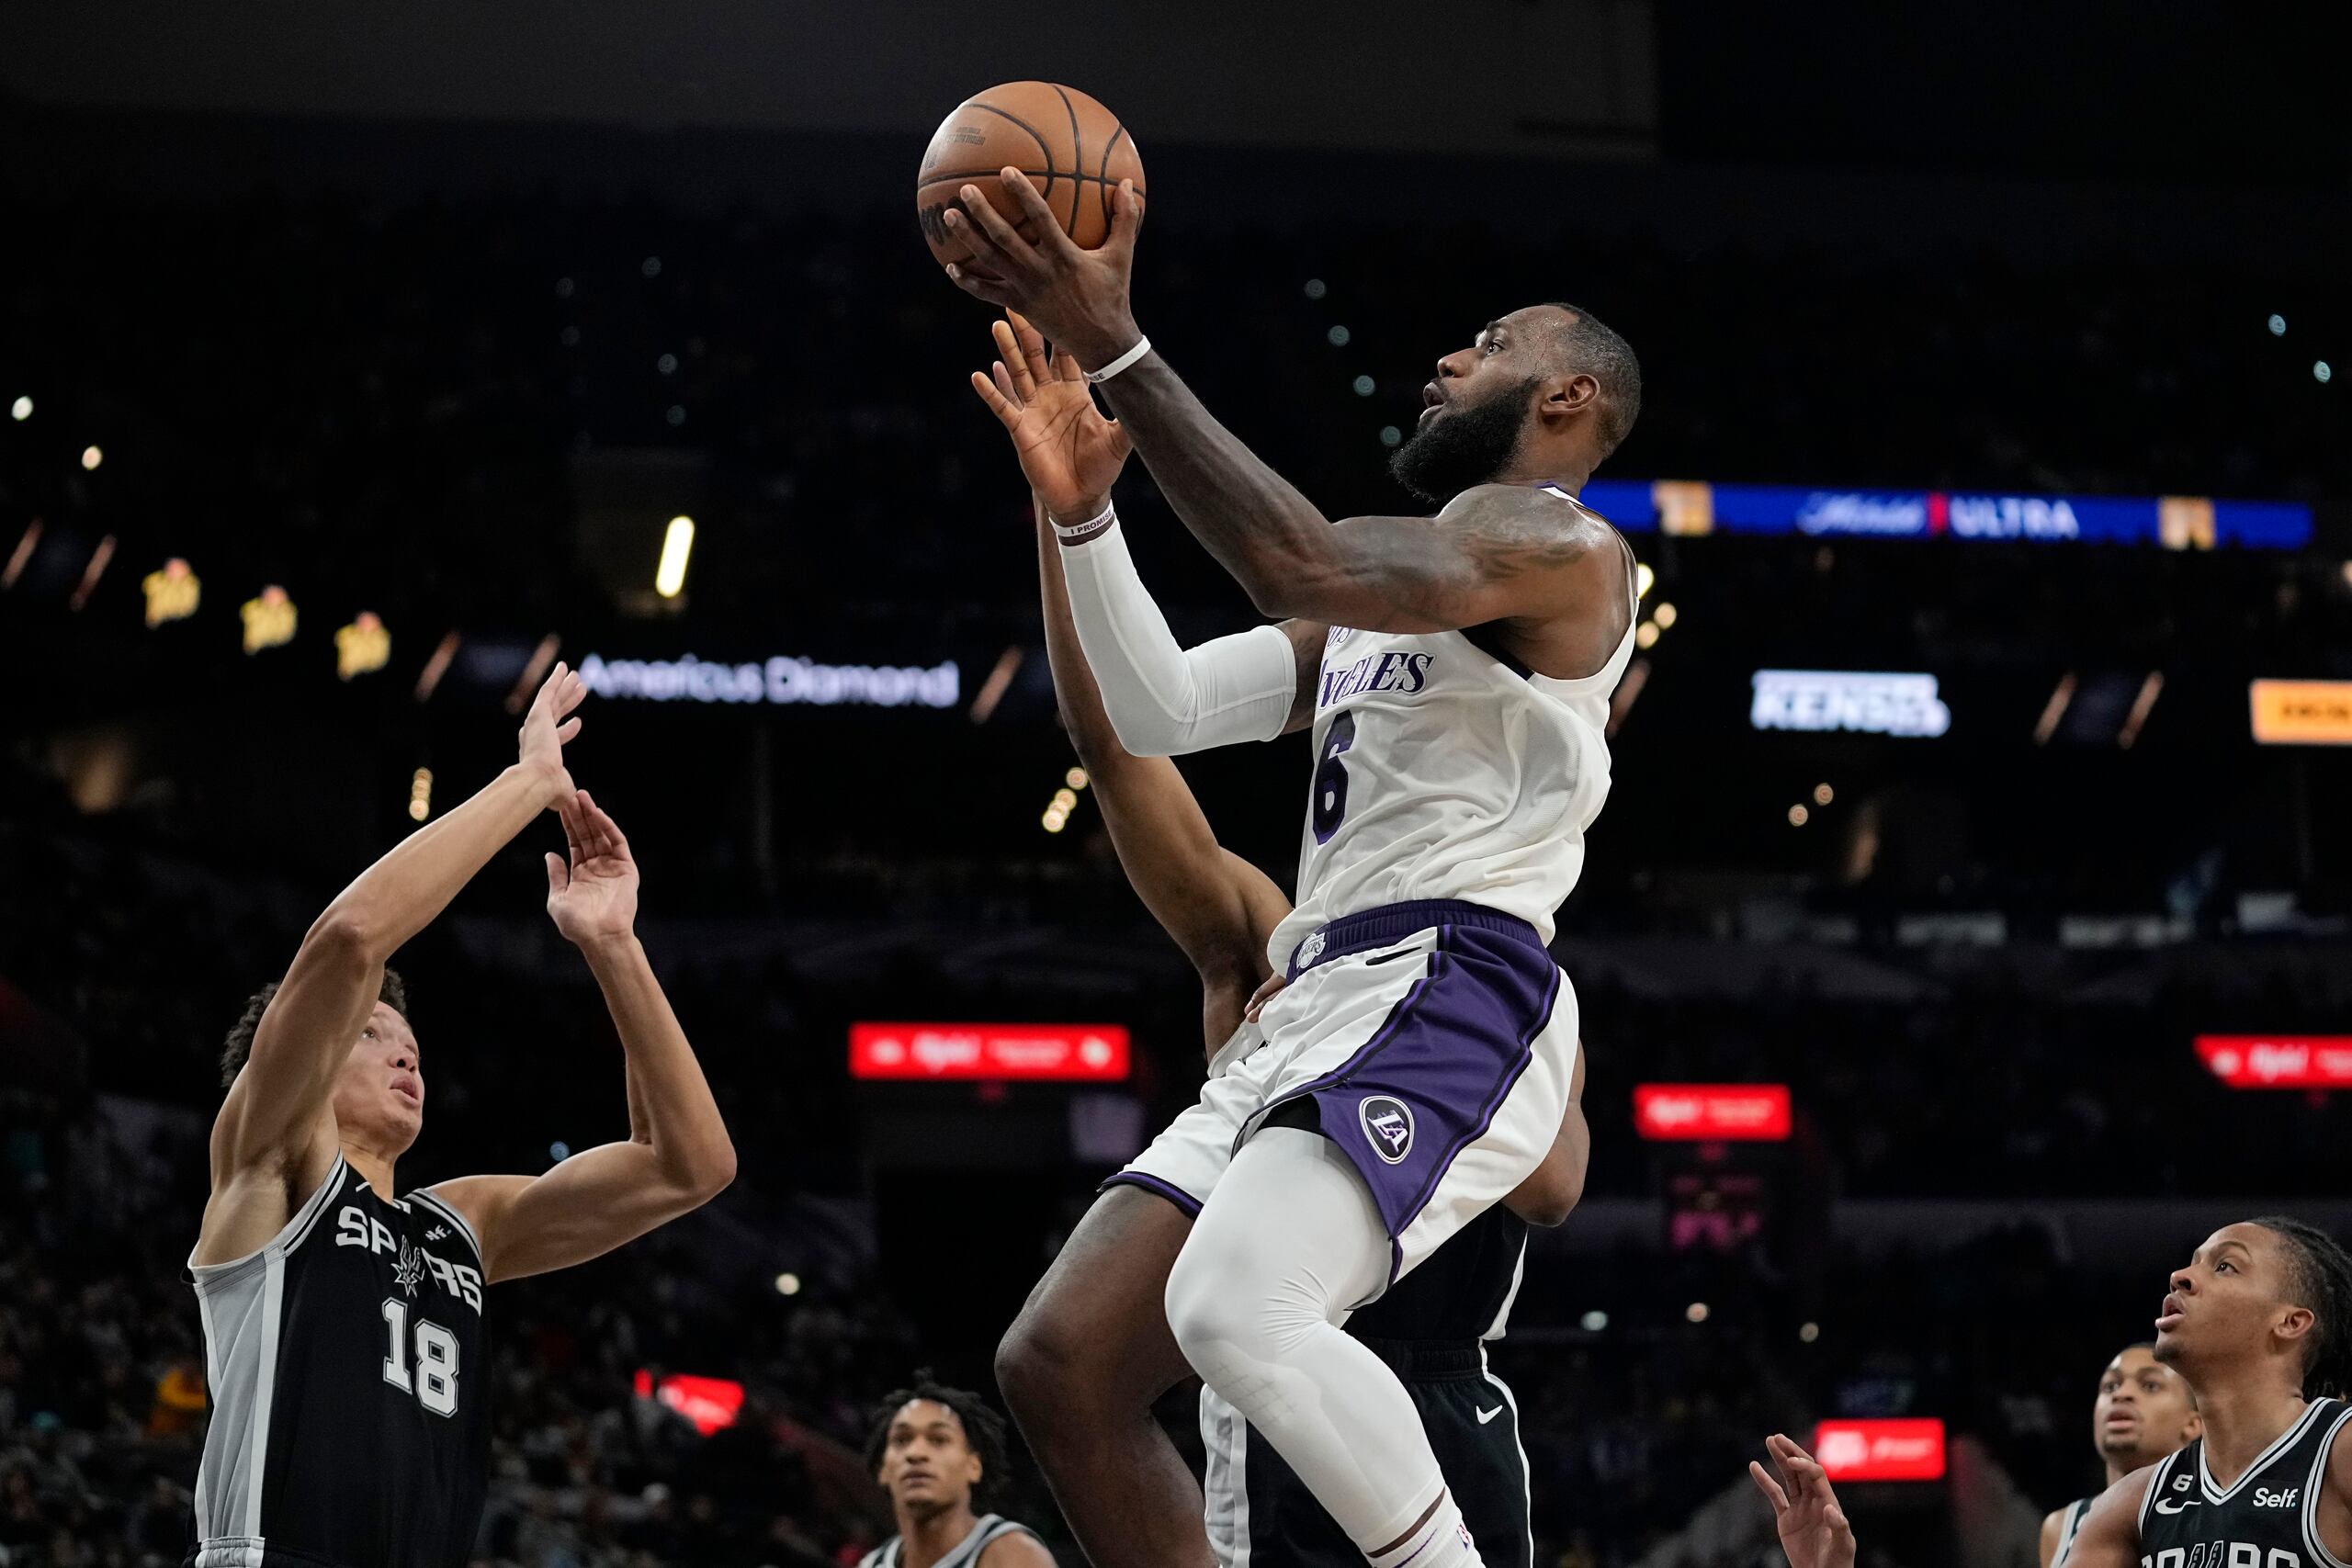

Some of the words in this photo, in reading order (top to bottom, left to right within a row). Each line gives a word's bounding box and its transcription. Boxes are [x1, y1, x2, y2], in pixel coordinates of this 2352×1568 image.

[1077, 510, 1112, 533] PROMISE
[1950, 496, 2080, 538] ULTRA
[765, 656, 960, 707] Diamond
[1313, 709, 1356, 846] 6
[1367, 1110, 1408, 1153] LA
[382, 1296, 459, 1418] 18
[2172, 1473, 2194, 1492] 6
